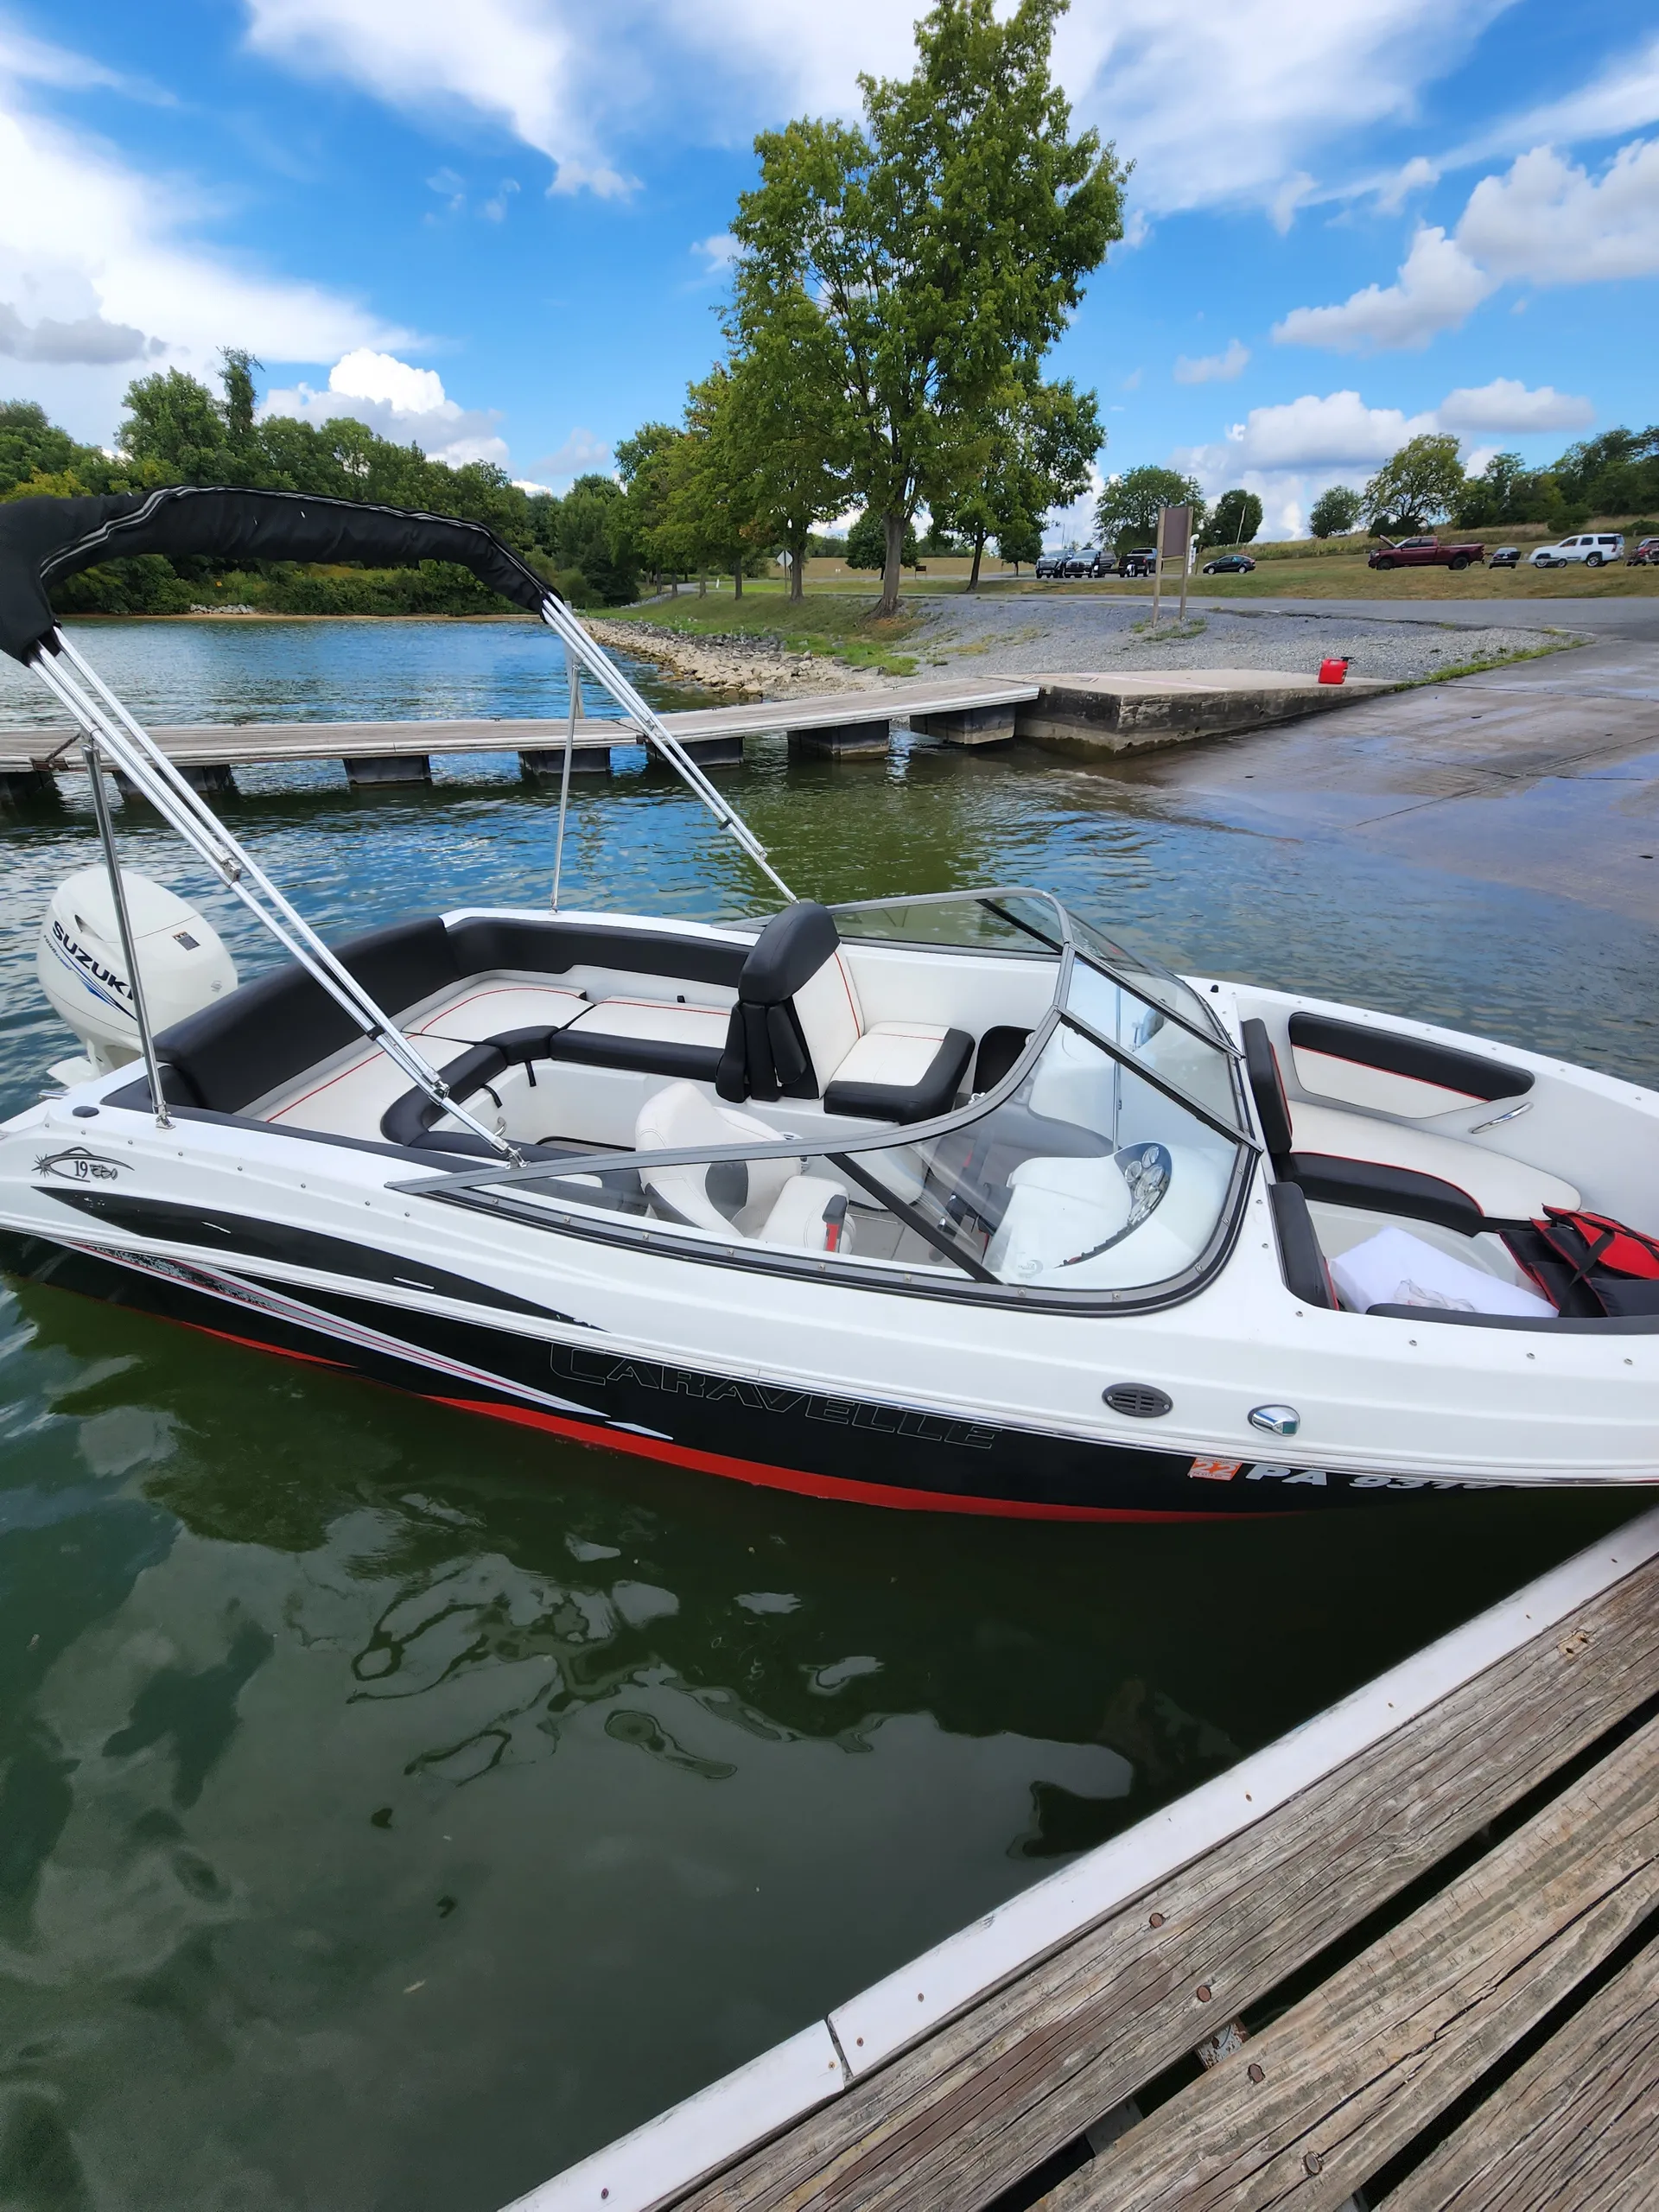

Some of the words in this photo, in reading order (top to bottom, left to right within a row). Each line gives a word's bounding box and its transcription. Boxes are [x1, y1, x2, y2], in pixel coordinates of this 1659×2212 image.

[73, 1160, 88, 1179] 19
[550, 1342, 1002, 1449] CARAVELLE
[1190, 1462, 1236, 1477] 22
[1245, 1464, 1327, 1485] PA
